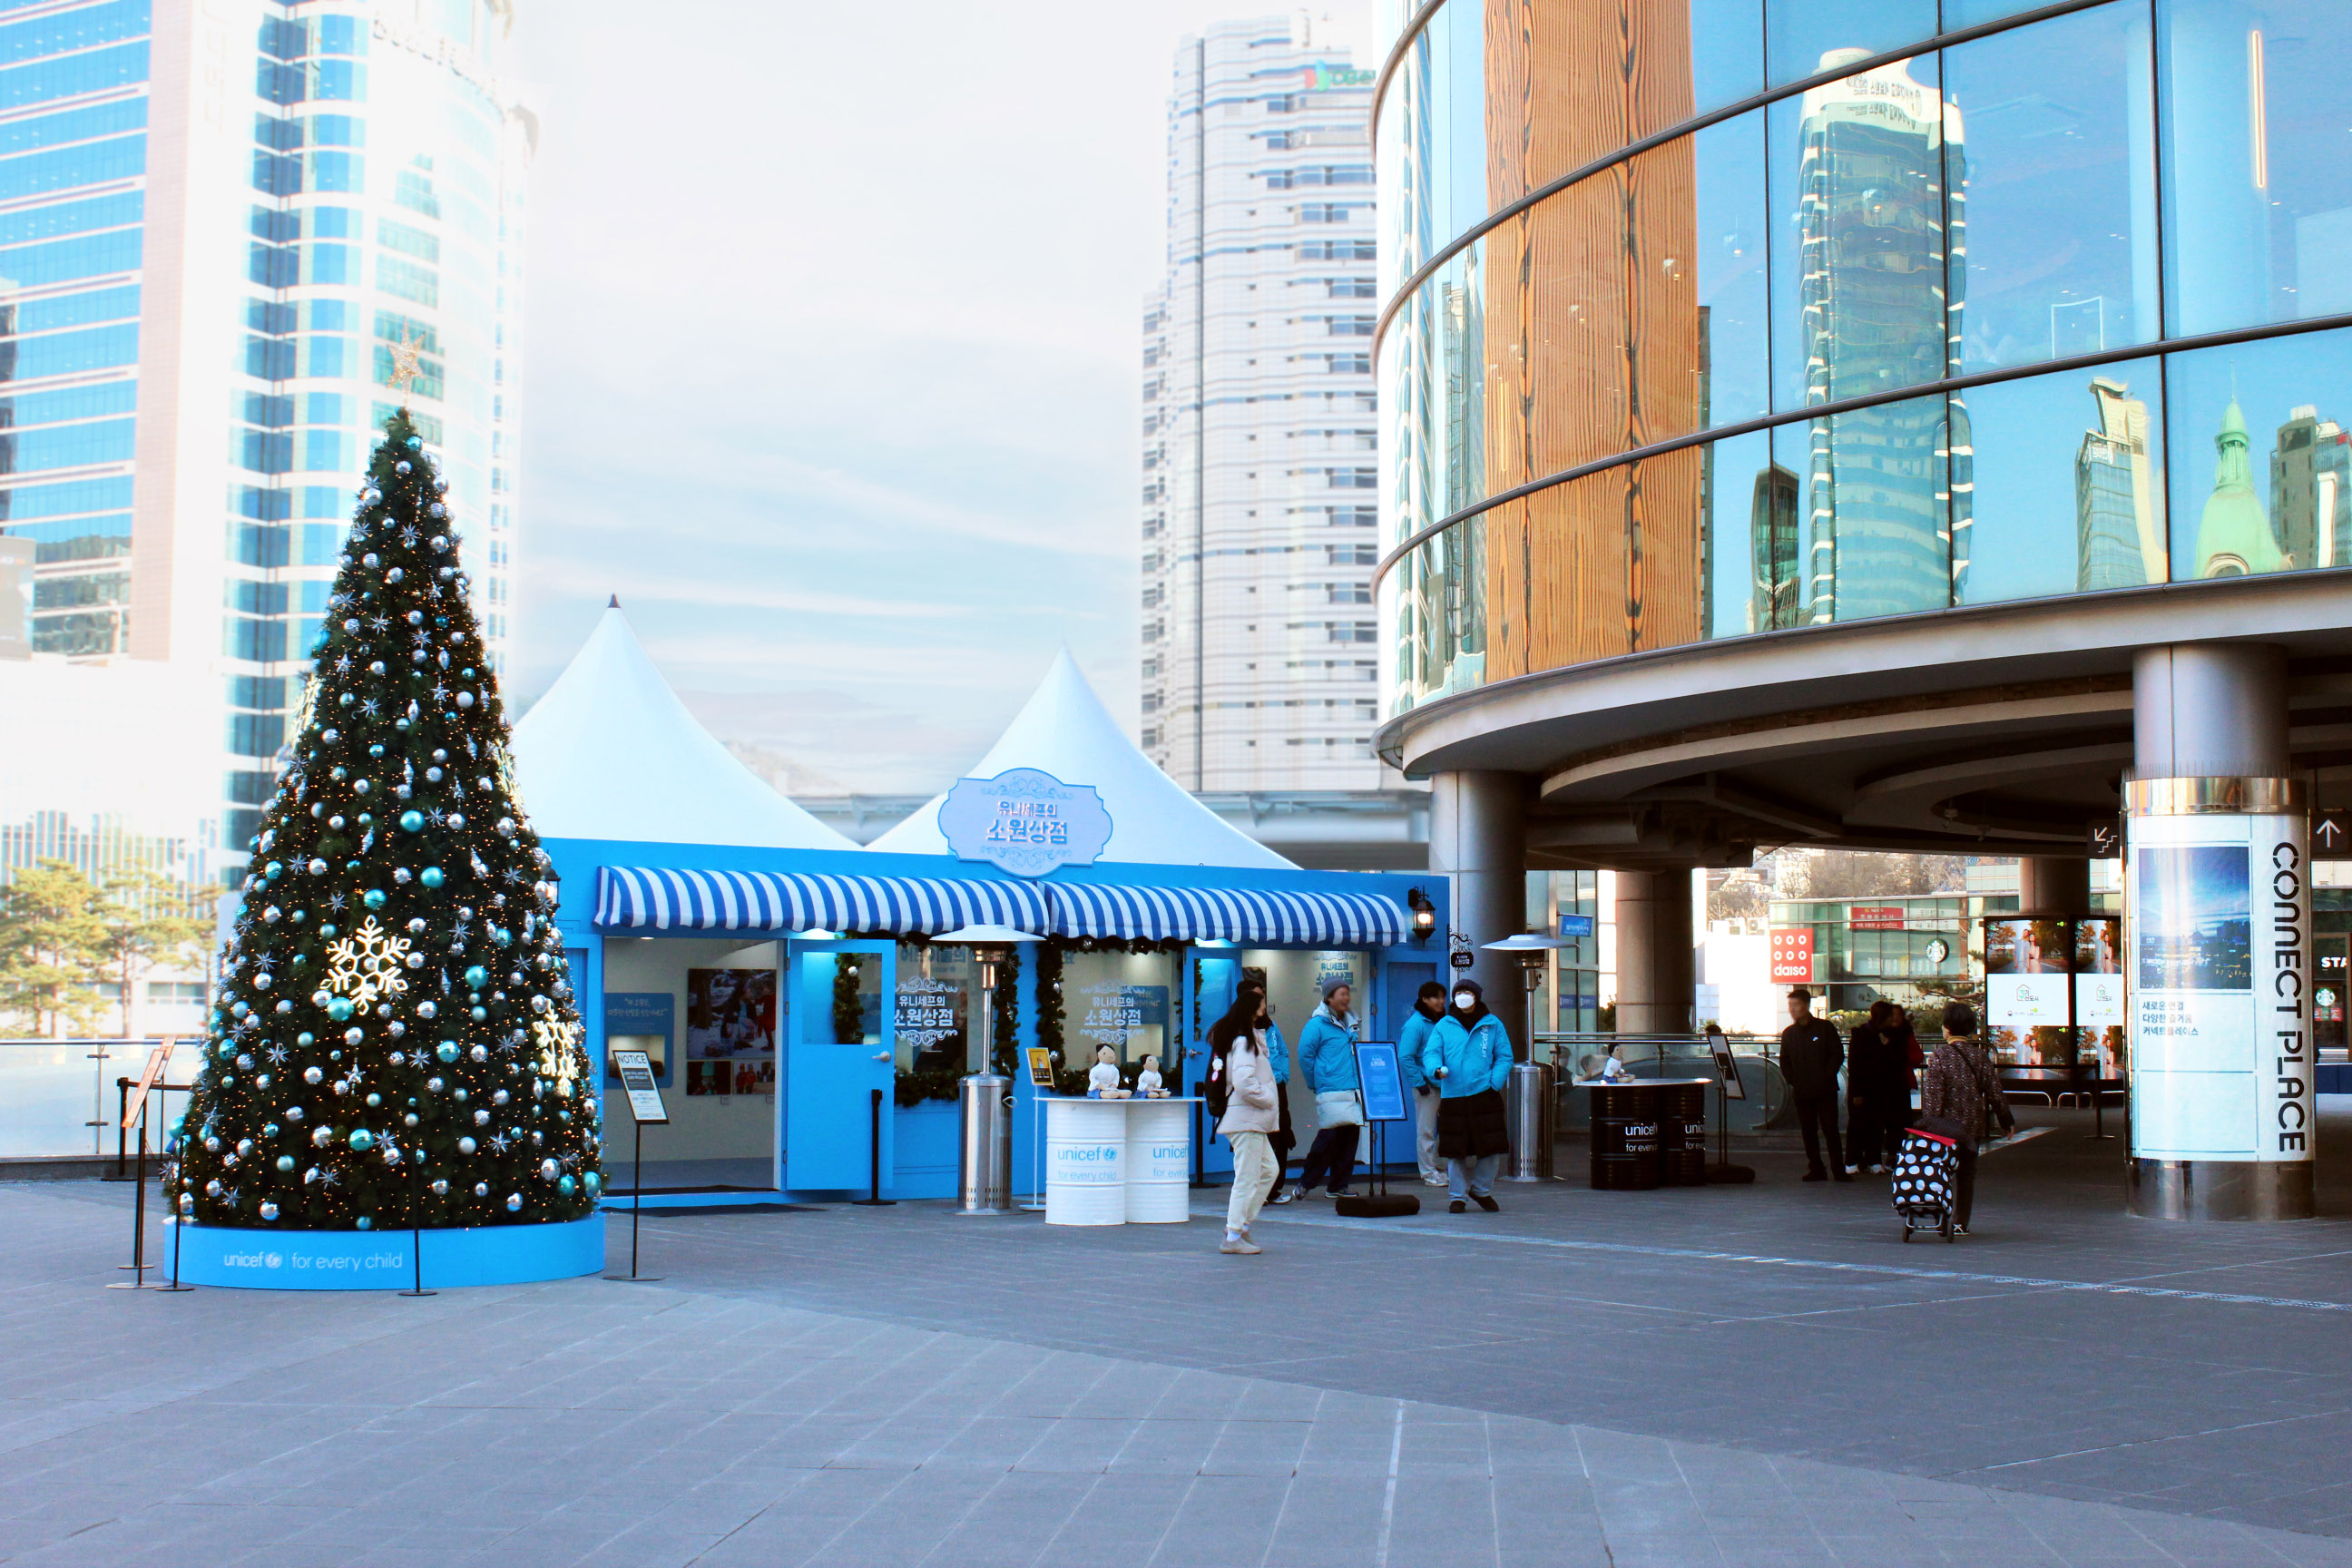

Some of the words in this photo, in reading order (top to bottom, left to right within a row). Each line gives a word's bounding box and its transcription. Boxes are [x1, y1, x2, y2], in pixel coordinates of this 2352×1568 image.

[998, 800, 1059, 818] 유니세프의
[986, 818, 1068, 845] 소원상점
[2272, 841, 2302, 1019] CONNECT
[1320, 962, 1349, 971] 유니세프의
[1774, 963, 1808, 976] daiso
[898, 995, 946, 1007] 유니세프의
[1092, 996, 1134, 1007] 유니세프의
[2142, 1001, 2166, 1011] 새로운
[2168, 1001, 2184, 1011] 연결
[894, 1008, 954, 1027] 소원상점
[1083, 1009, 1142, 1026] 소원상점
[2142, 1014, 2166, 1024] 다양한
[2142, 1026, 2199, 1036] 커넥트플레이스
[617, 1054, 647, 1065] NOTICE
[2277, 1030, 2306, 1152] PLACE
[1625, 1142, 1637, 1152] for
[1685, 1141, 1695, 1150] for
[1058, 1146, 1102, 1161] unicef
[1058, 1169, 1068, 1179] for
[1070, 1171, 1097, 1181] every
[1098, 1169, 1117, 1181] child
[1153, 1168, 1165, 1177] for
[223, 1251, 263, 1268] unicef
[292, 1252, 313, 1269] for
[316, 1255, 362, 1272] every
[365, 1252, 403, 1269] child
